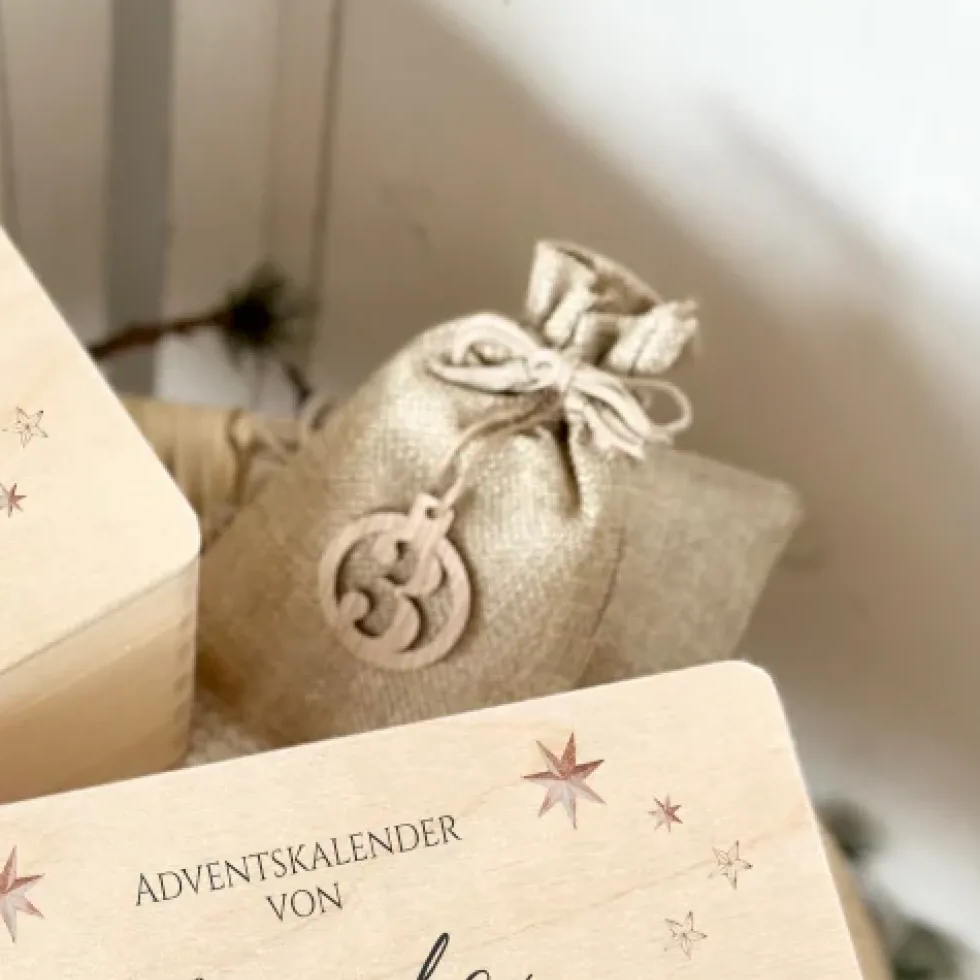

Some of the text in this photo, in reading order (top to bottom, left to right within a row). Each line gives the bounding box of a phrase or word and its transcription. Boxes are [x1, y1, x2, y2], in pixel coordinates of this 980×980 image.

[335, 529, 442, 653] 3
[135, 815, 462, 905] ADVENTSKALENDER
[265, 883, 343, 921] VON
